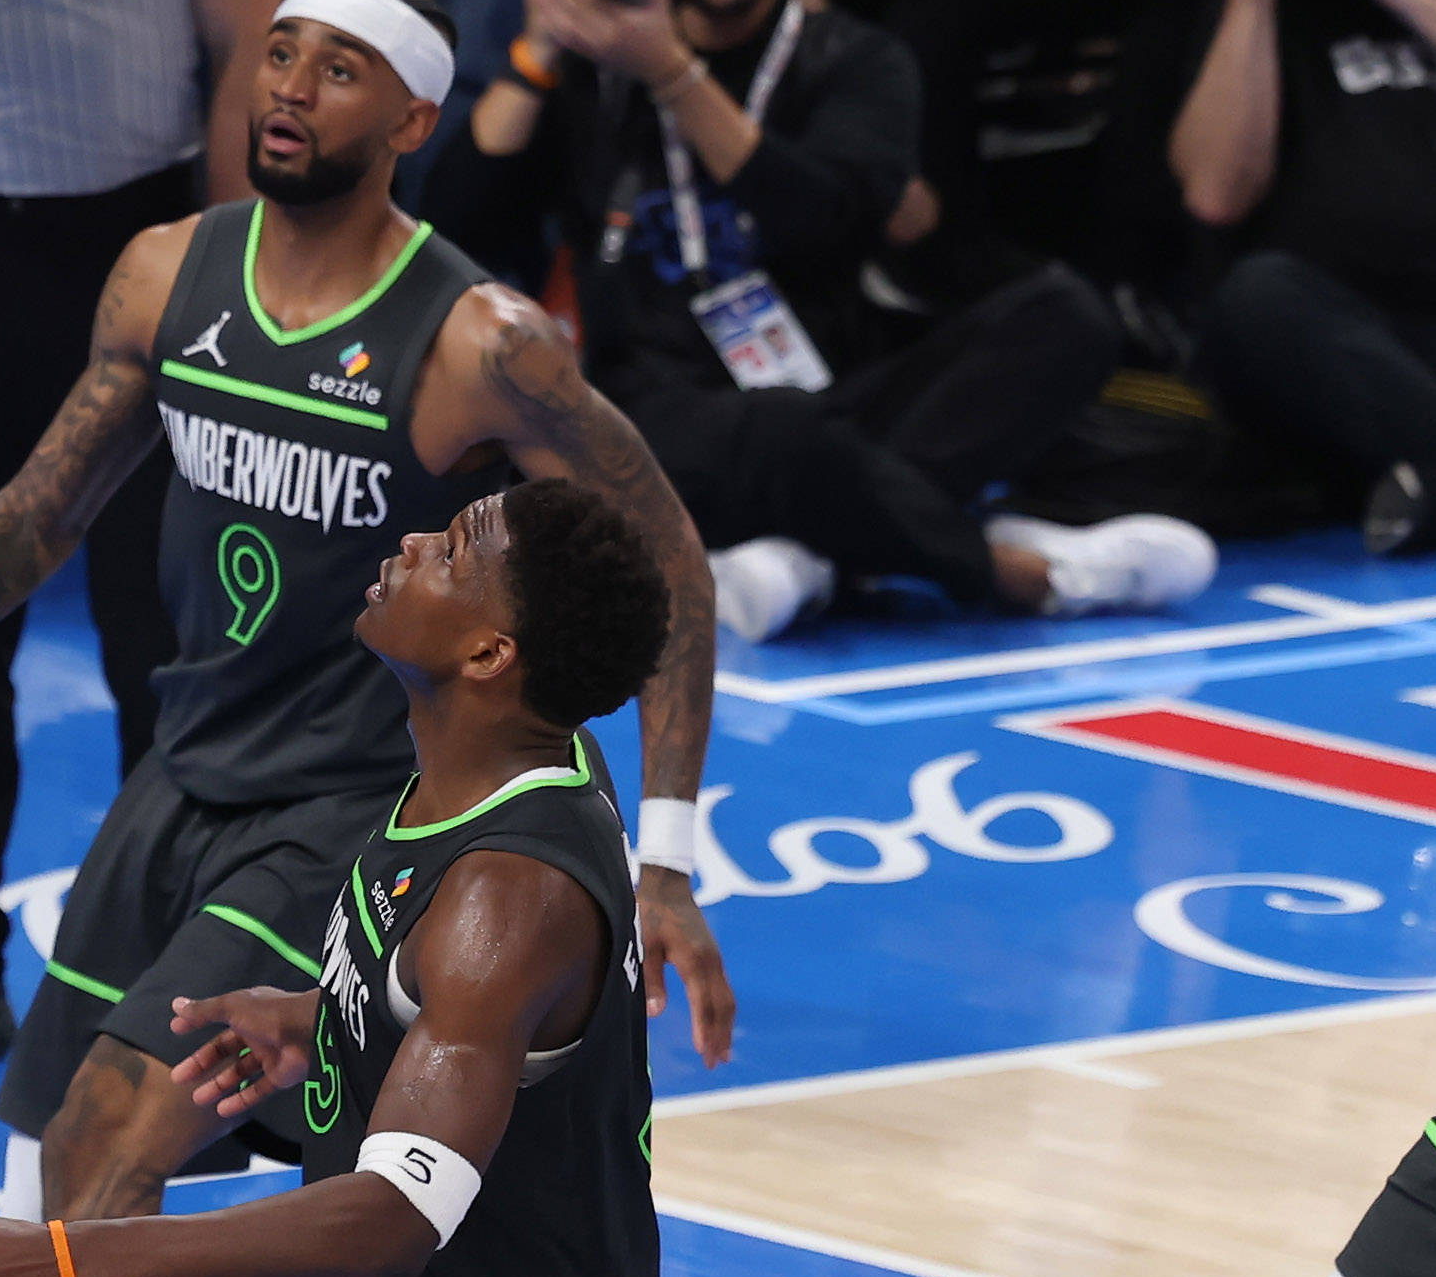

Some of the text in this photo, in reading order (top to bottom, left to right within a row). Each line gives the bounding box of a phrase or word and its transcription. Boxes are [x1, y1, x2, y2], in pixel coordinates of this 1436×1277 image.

[307, 372, 383, 406] sezzle
[217, 522, 283, 647] 9
[370, 879, 398, 933] sezzle
[400, 1146, 438, 1186] 5
